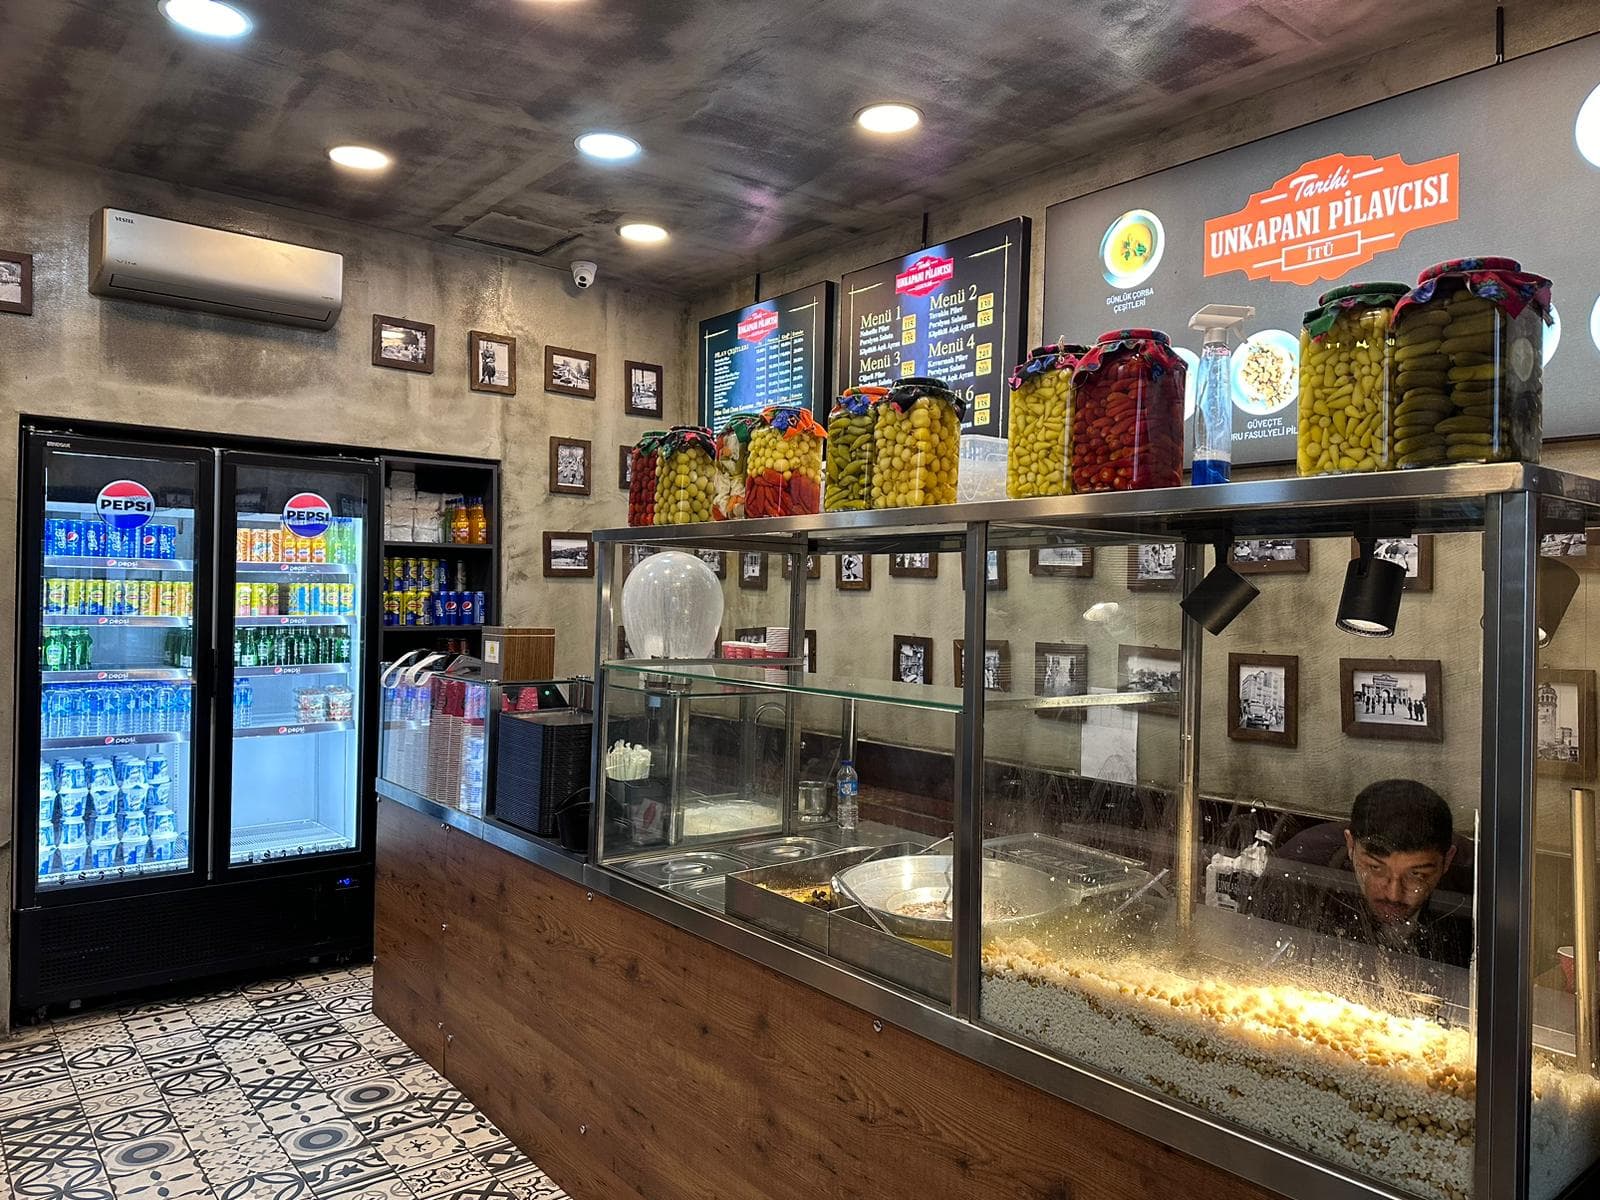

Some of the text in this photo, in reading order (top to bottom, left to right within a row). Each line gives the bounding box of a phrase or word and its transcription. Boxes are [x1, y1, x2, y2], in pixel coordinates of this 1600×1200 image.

[1289, 165, 1350, 202] Tarihi
[1210, 172, 1450, 259] UNKAPANI PİLAVCISI
[1307, 241, 1335, 262] İTÜ
[929, 284, 978, 311] Menü 2
[1106, 288, 1154, 305] GÜNLÜK ÇORBA
[1113, 297, 1146, 314] ÇEŞİTLERİ
[860, 305, 901, 330] Menü 1
[928, 333, 975, 359] Menü 4
[858, 351, 901, 374] Menü 3
[965, 384, 975, 401] 6
[1244, 426, 1285, 440] FASULYELİ
[1247, 417, 1283, 430] GÜVEÇTE
[101, 499, 152, 512] PEPSI
[287, 510, 330, 522] PEPSI
